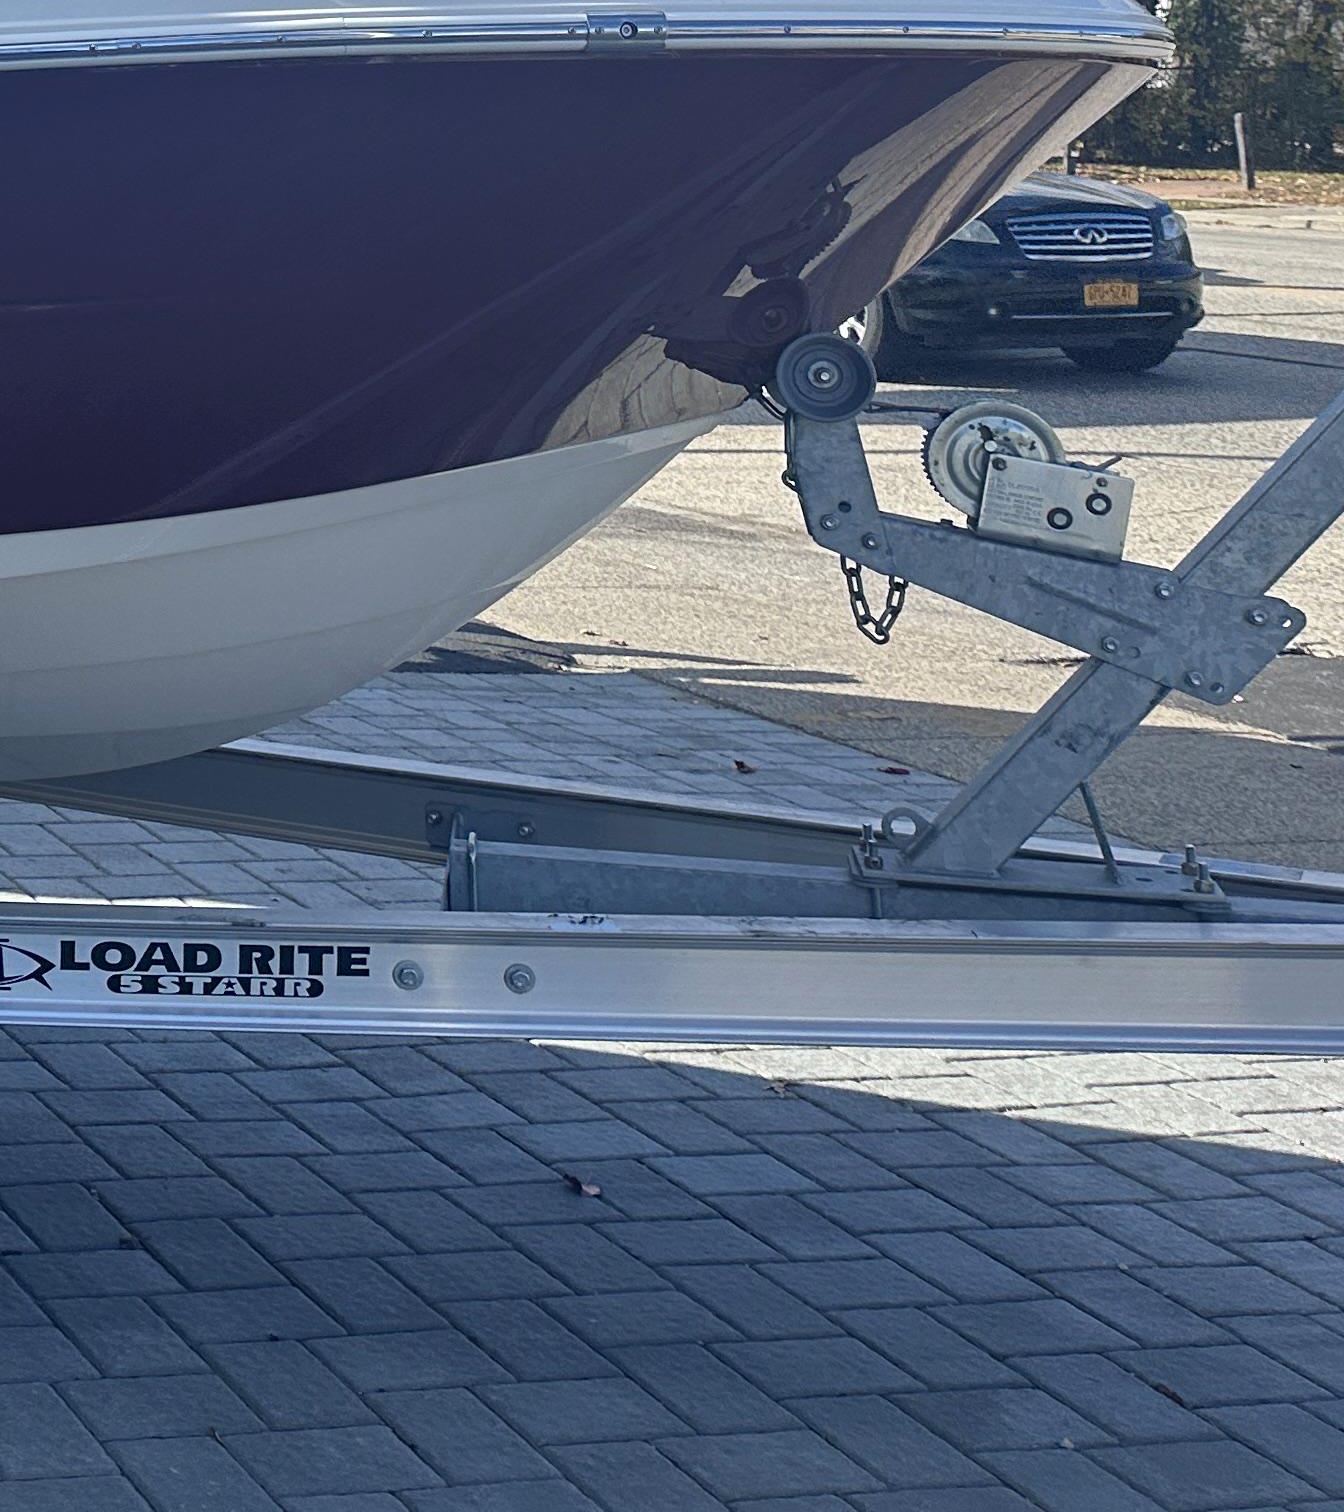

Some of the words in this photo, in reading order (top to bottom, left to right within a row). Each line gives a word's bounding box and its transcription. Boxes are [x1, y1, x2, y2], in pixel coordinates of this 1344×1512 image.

[59, 940, 222, 974] LOAD
[238, 944, 371, 977] RITE
[119, 975, 143, 993] 5
